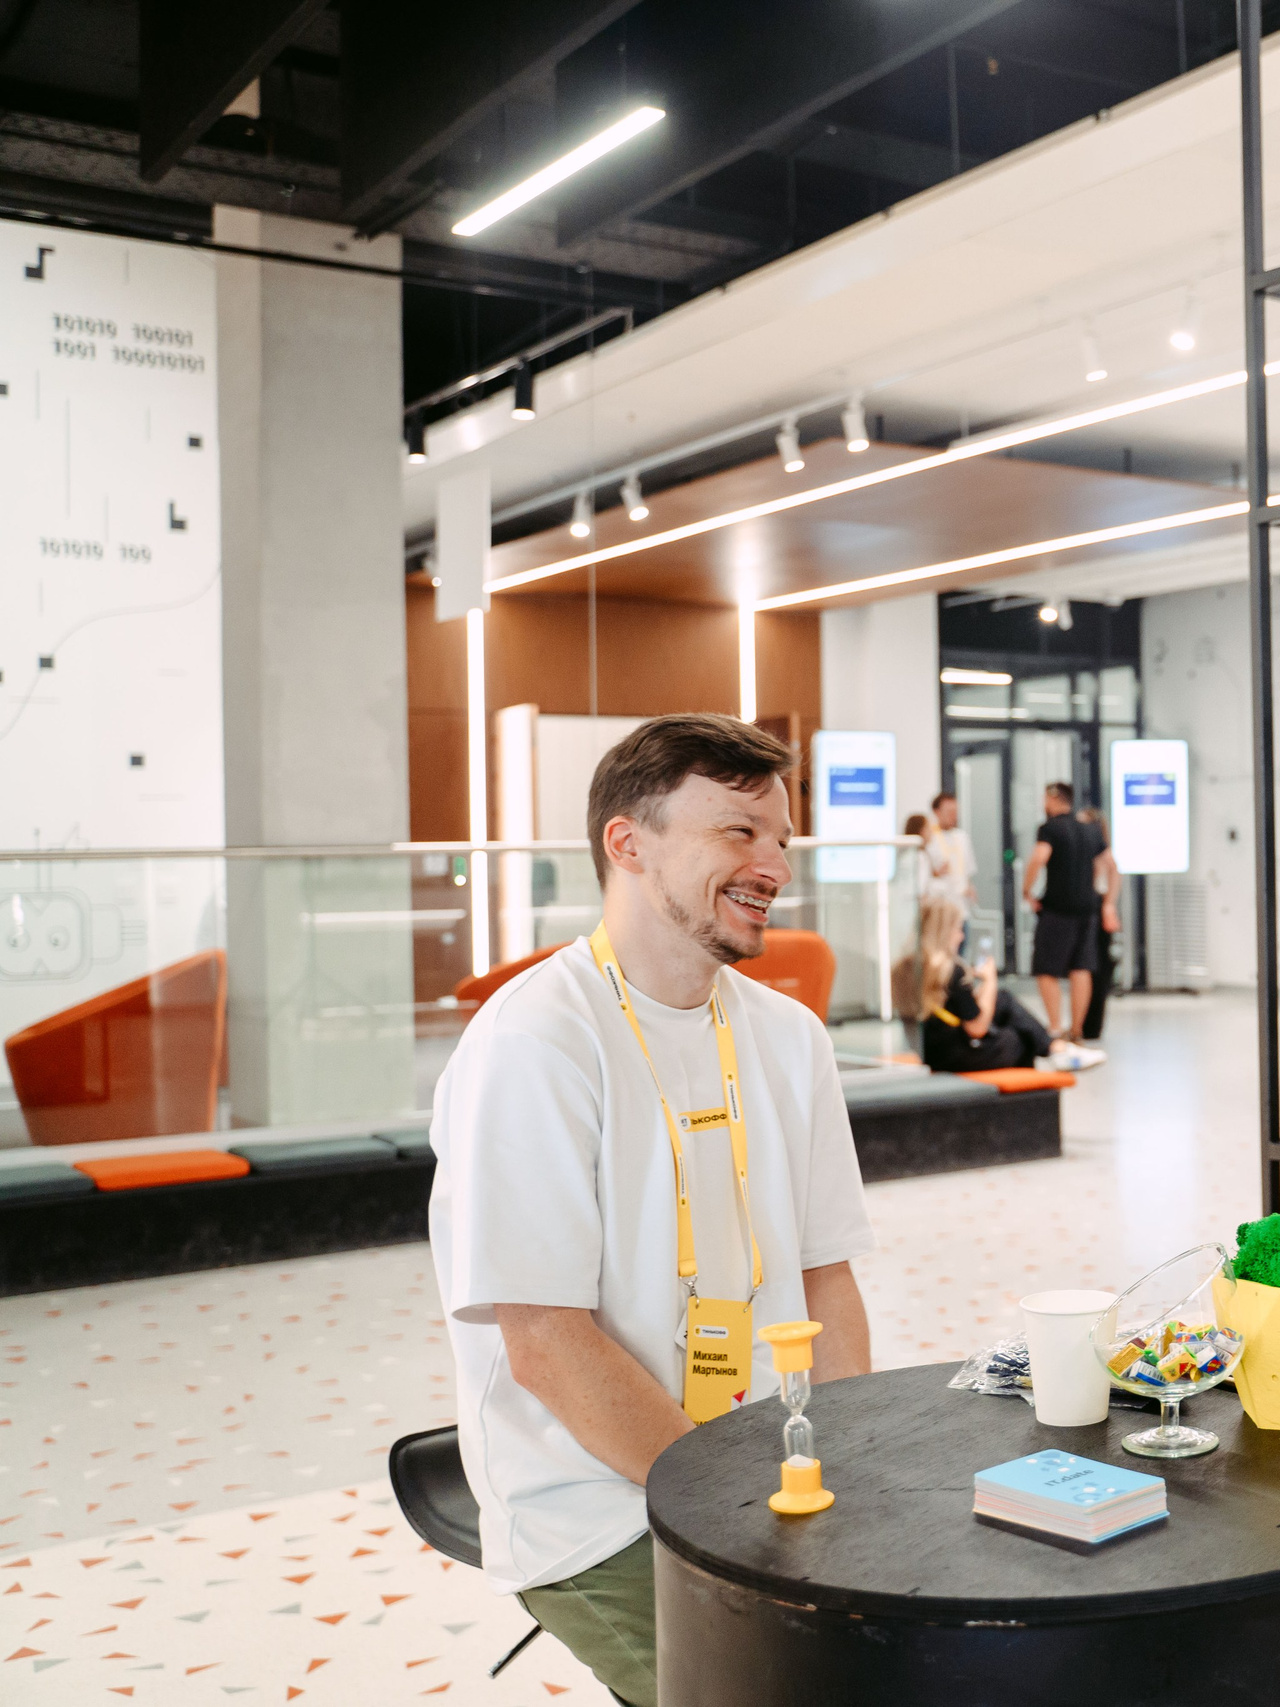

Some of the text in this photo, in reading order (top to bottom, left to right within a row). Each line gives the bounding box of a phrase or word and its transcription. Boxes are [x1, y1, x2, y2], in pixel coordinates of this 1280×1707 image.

[53, 313, 193, 346] 101010 100101
[53, 337, 96, 360] 1001
[690, 1113, 727, 1126] ЬКОФФ
[693, 1350, 728, 1361] Михаил
[692, 1364, 738, 1377] Мартынов
